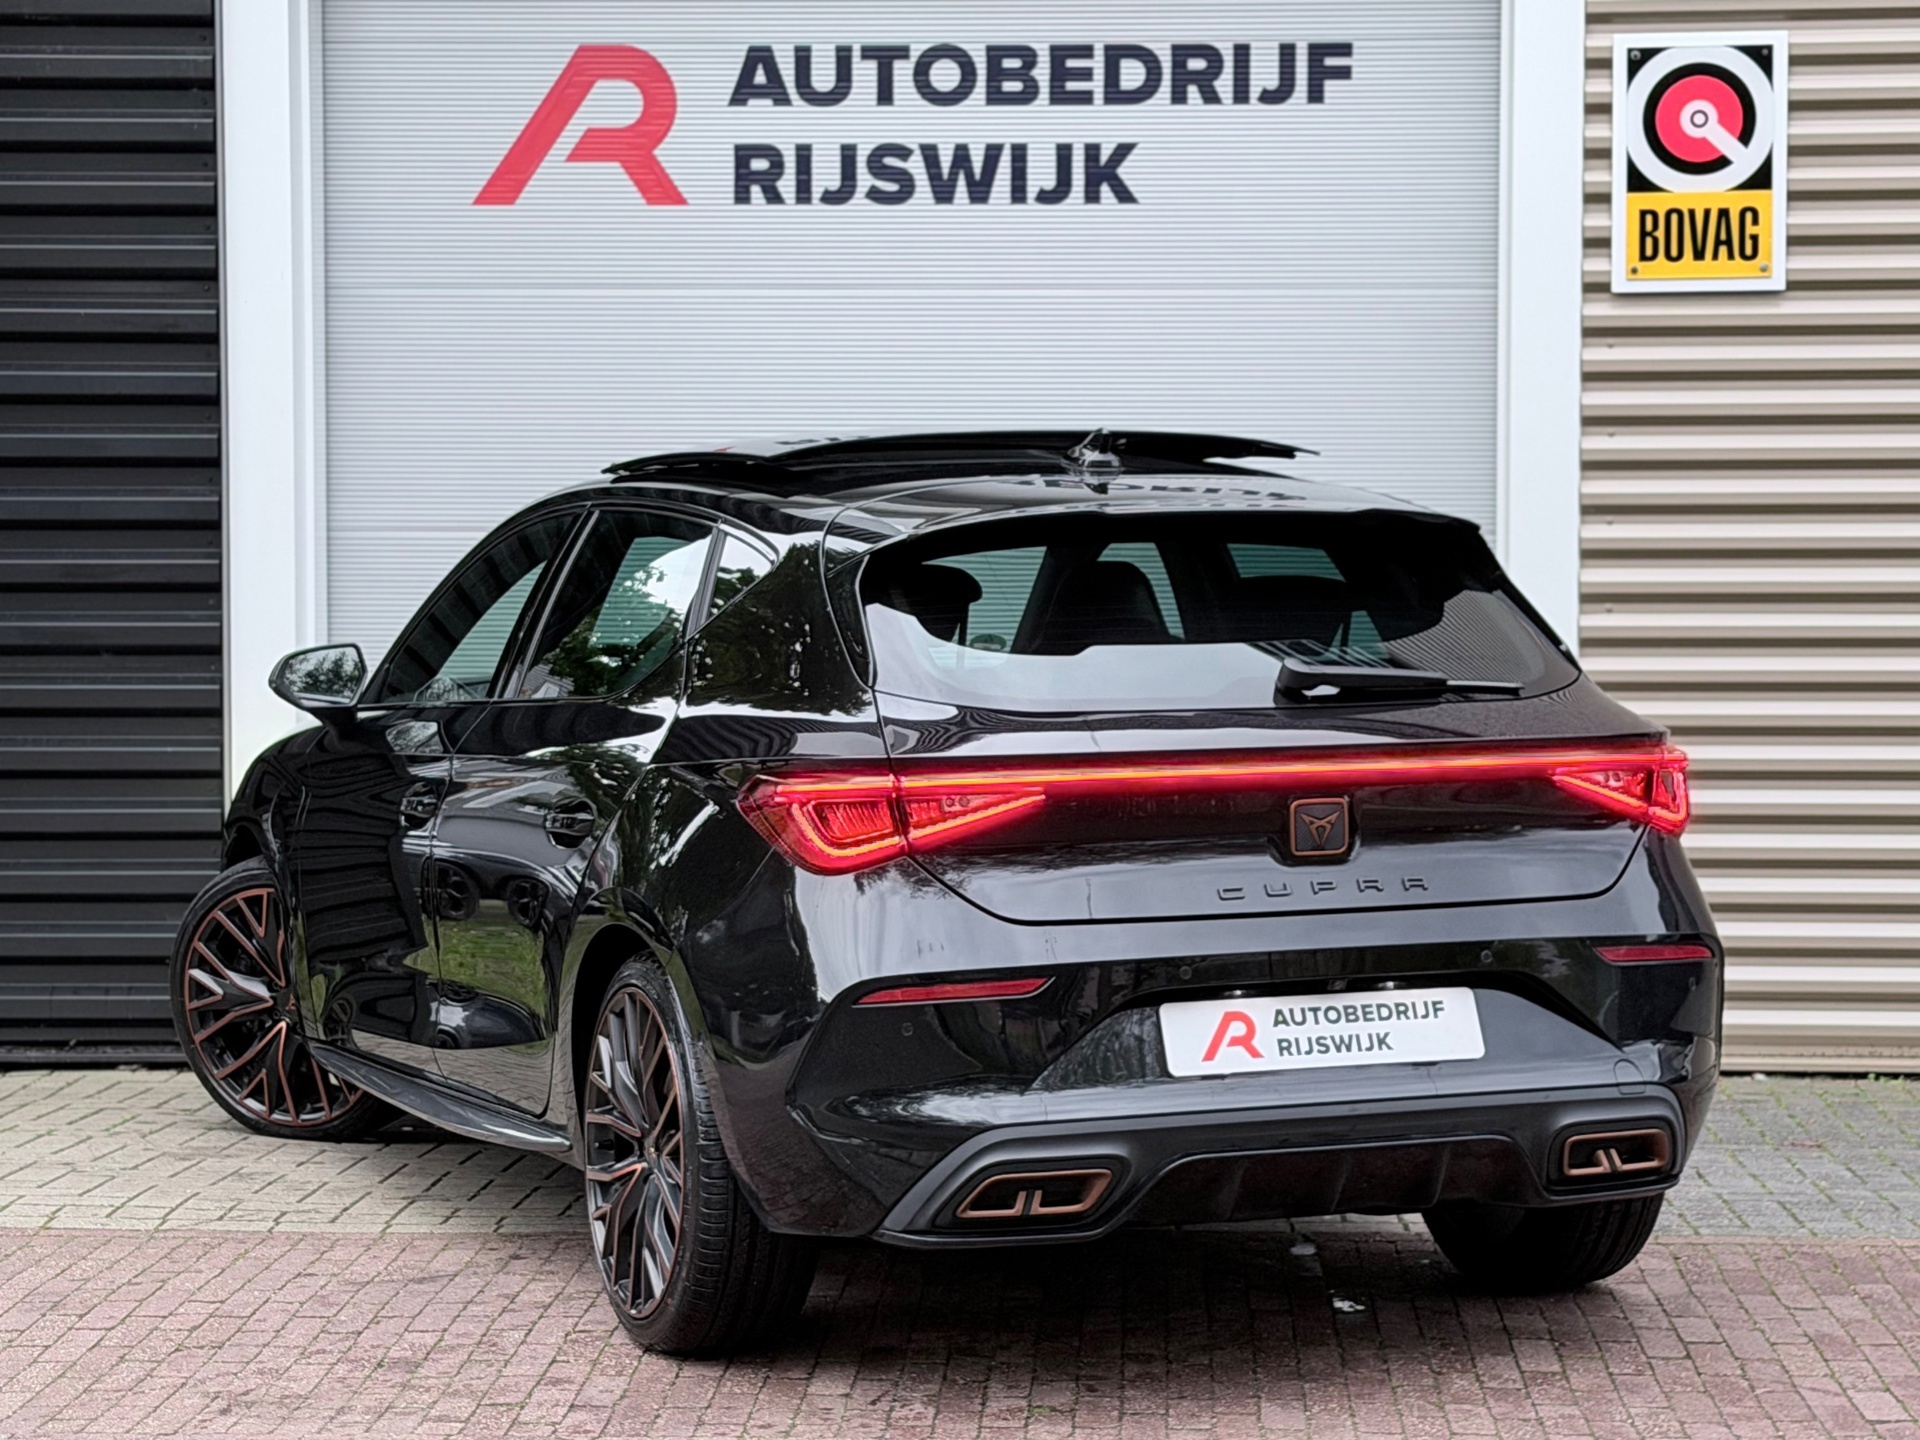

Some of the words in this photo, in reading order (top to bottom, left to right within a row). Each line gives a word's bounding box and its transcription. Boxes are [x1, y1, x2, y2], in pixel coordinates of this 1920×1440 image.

[728, 42, 1354, 107] AUTOBEDRIJF
[733, 143, 1140, 205] RIJSWIJK
[1638, 206, 1760, 263] BOVAG
[1217, 876, 1428, 901] CUPRA
[1272, 1000, 1446, 1028] AUTOBEDRIJF
[1276, 1031, 1394, 1057] RIJSWIJK
